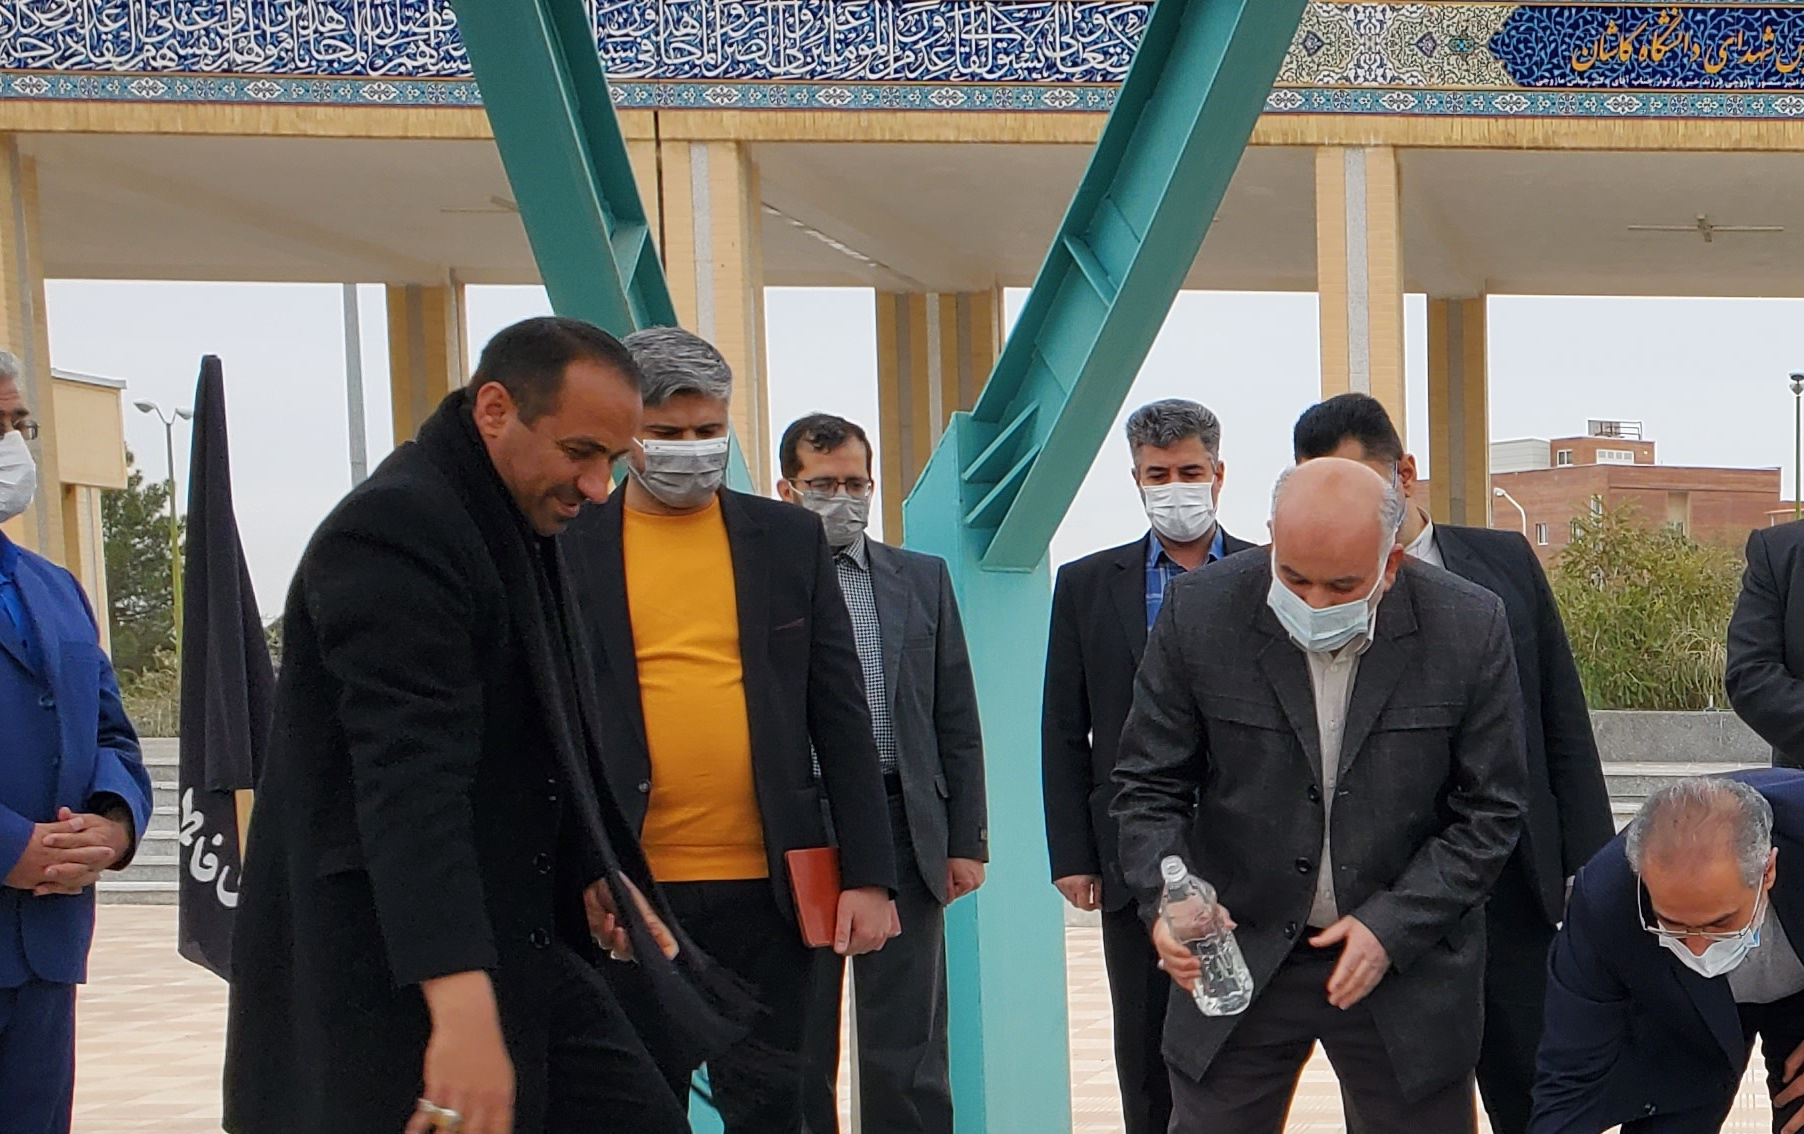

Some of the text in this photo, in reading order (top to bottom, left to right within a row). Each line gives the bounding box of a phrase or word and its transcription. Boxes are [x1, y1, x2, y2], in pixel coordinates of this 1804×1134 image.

[1571, 20, 1645, 72] کاشان
[1639, 8, 1701, 63] دانشگاه
[1704, 26, 1775, 73] شهدای
